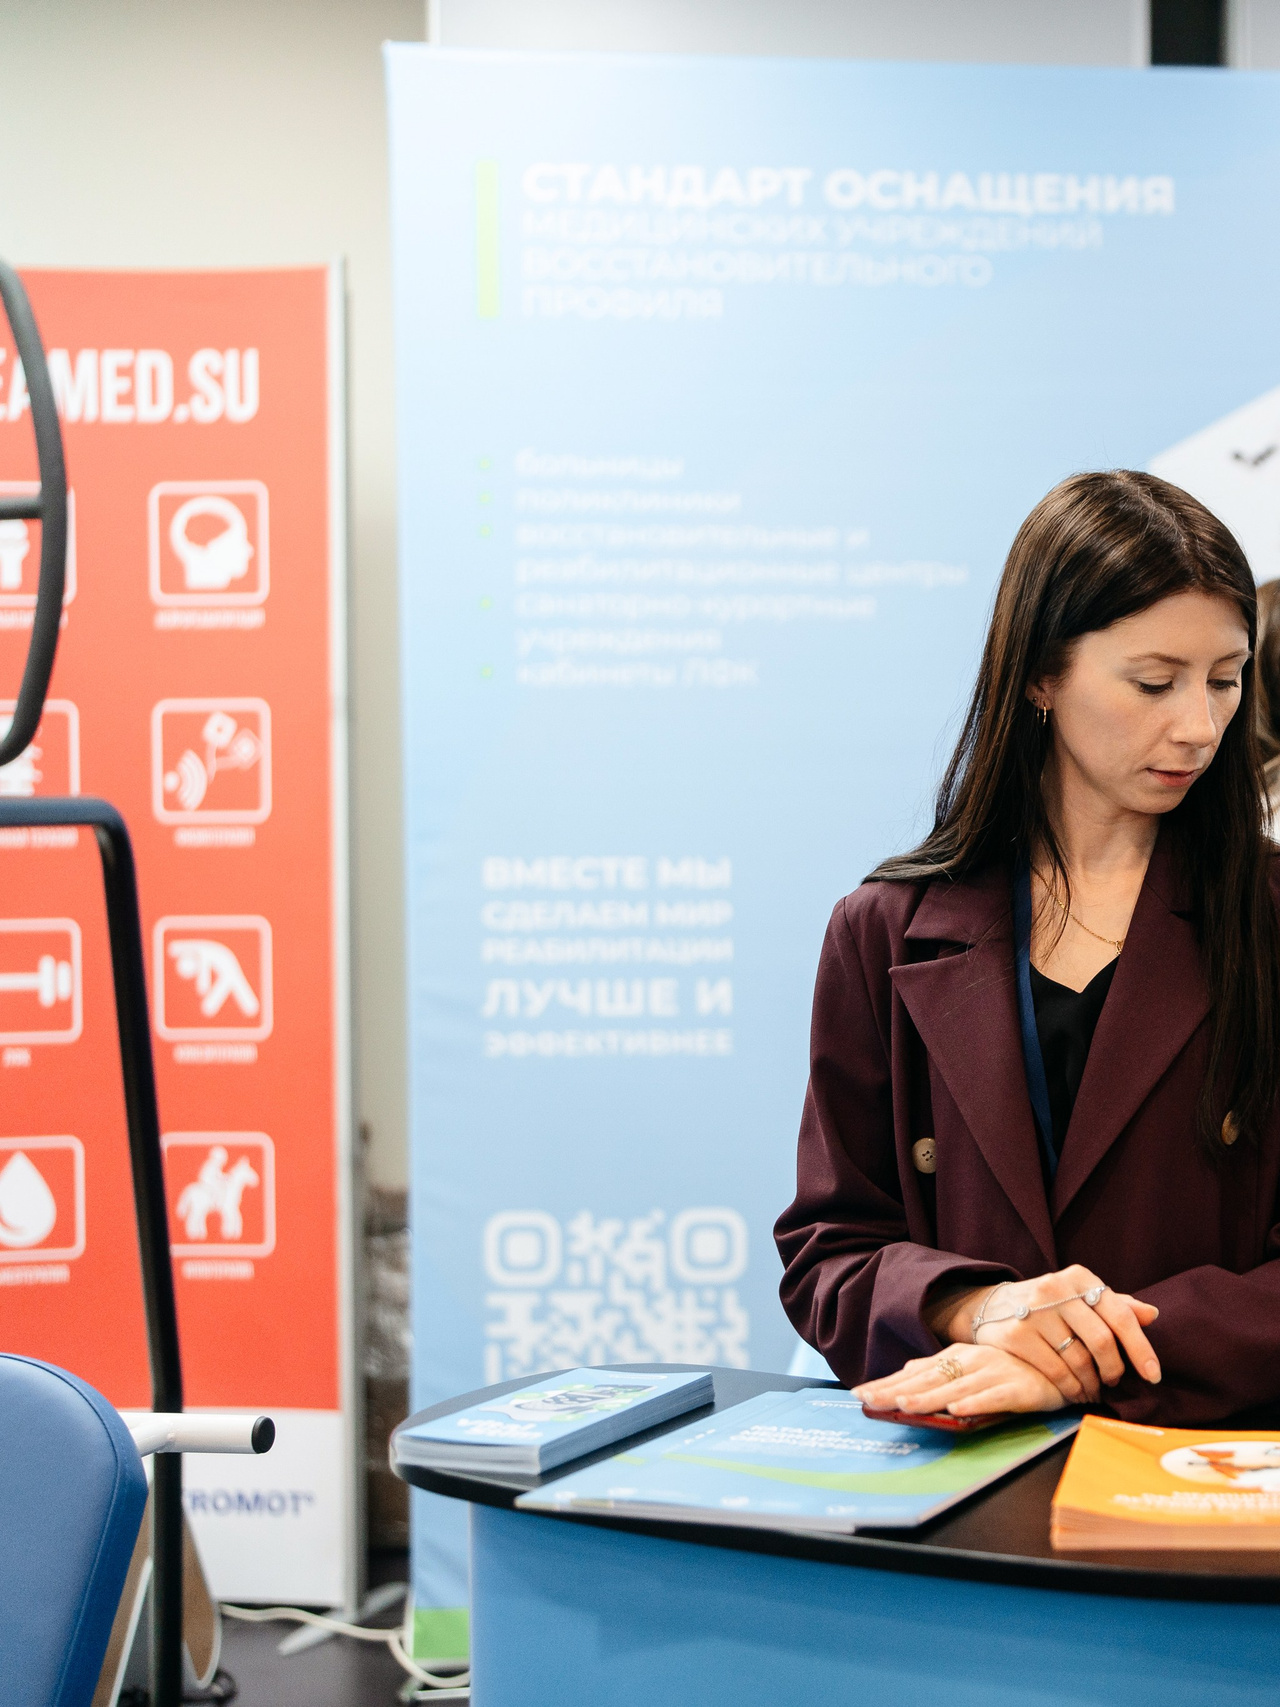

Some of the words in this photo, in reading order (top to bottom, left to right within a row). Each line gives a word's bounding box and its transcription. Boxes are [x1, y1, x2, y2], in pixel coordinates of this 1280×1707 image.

[521, 162, 812, 208] СТАНДАРТ
[824, 168, 1176, 216] ОСНАЩЕНИЯ
[521, 211, 828, 246] МЕДИЦИНСКИХ
[838, 213, 1103, 250] УЧРЕЖДЕНИЙ
[521, 247, 993, 288] ВОССТАНОВИТЕЛЬНОГО
[521, 288, 724, 320] ПРОФИЛЯ
[0, 348, 260, 424] AMED.SU
[483, 856, 648, 890] ВМЕСТЕ
[657, 856, 732, 890] МЫ
[482, 900, 648, 931] СДЕЛАЕМ
[656, 900, 734, 928] МИР
[482, 936, 734, 966] РЕАБИЛИТАЦИИ
[482, 977, 679, 1018] ЛУЧШЕ
[695, 976, 733, 1017] И
[484, 1028, 734, 1058] ЭФФЕКТИВНЕЕ
[184, 1489, 305, 1515] ROMOT
